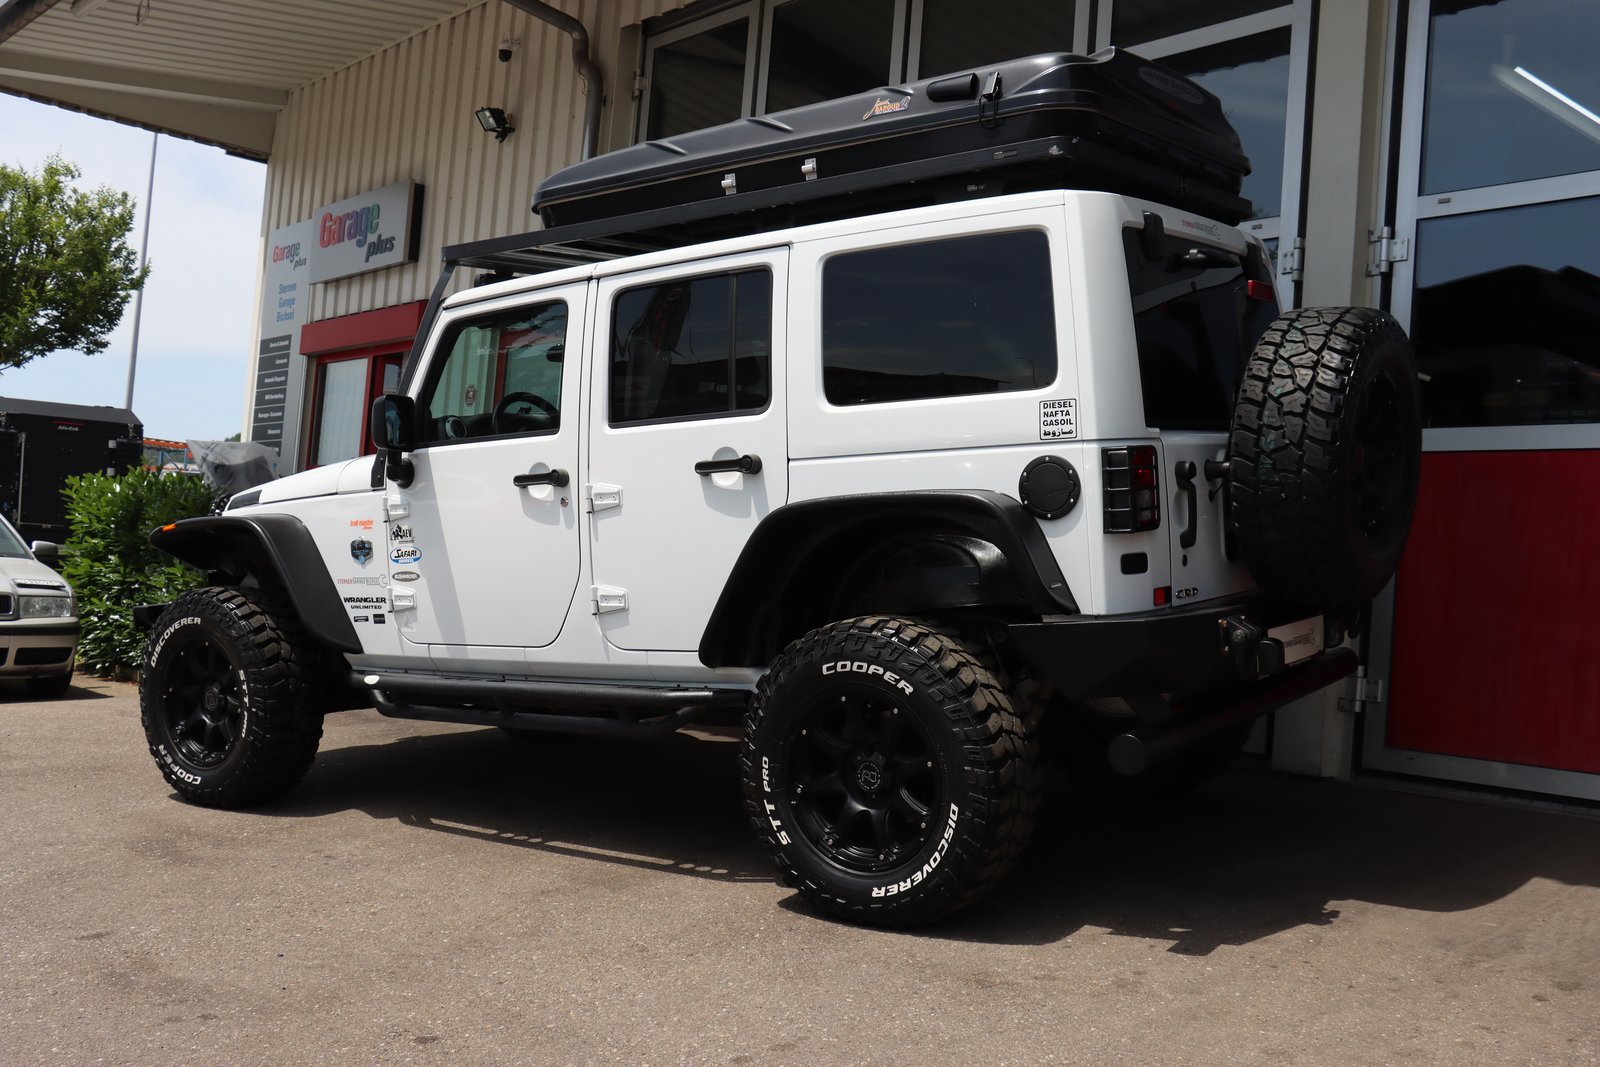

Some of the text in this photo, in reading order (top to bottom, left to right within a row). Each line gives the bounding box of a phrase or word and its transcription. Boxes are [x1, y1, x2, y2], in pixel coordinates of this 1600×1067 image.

[319, 202, 381, 249] Garage
[273, 242, 301, 264] Garage
[365, 233, 396, 263] plus
[293, 257, 307, 271] plus
[278, 296, 296, 309] Garage
[1043, 401, 1073, 409] DIESEL
[1043, 410, 1070, 418] NAFTA
[1043, 418, 1073, 426] GASOIL
[403, 529, 412, 538] AEV
[394, 549, 417, 559] SAFARI
[150, 616, 202, 668] DISCOVERER
[822, 660, 915, 696] COOPER
[238, 669, 249, 738] STT PRO
[158, 743, 202, 785] COOPER
[761, 756, 792, 846] STT PRO
[871, 802, 960, 898] DISCOVERER
